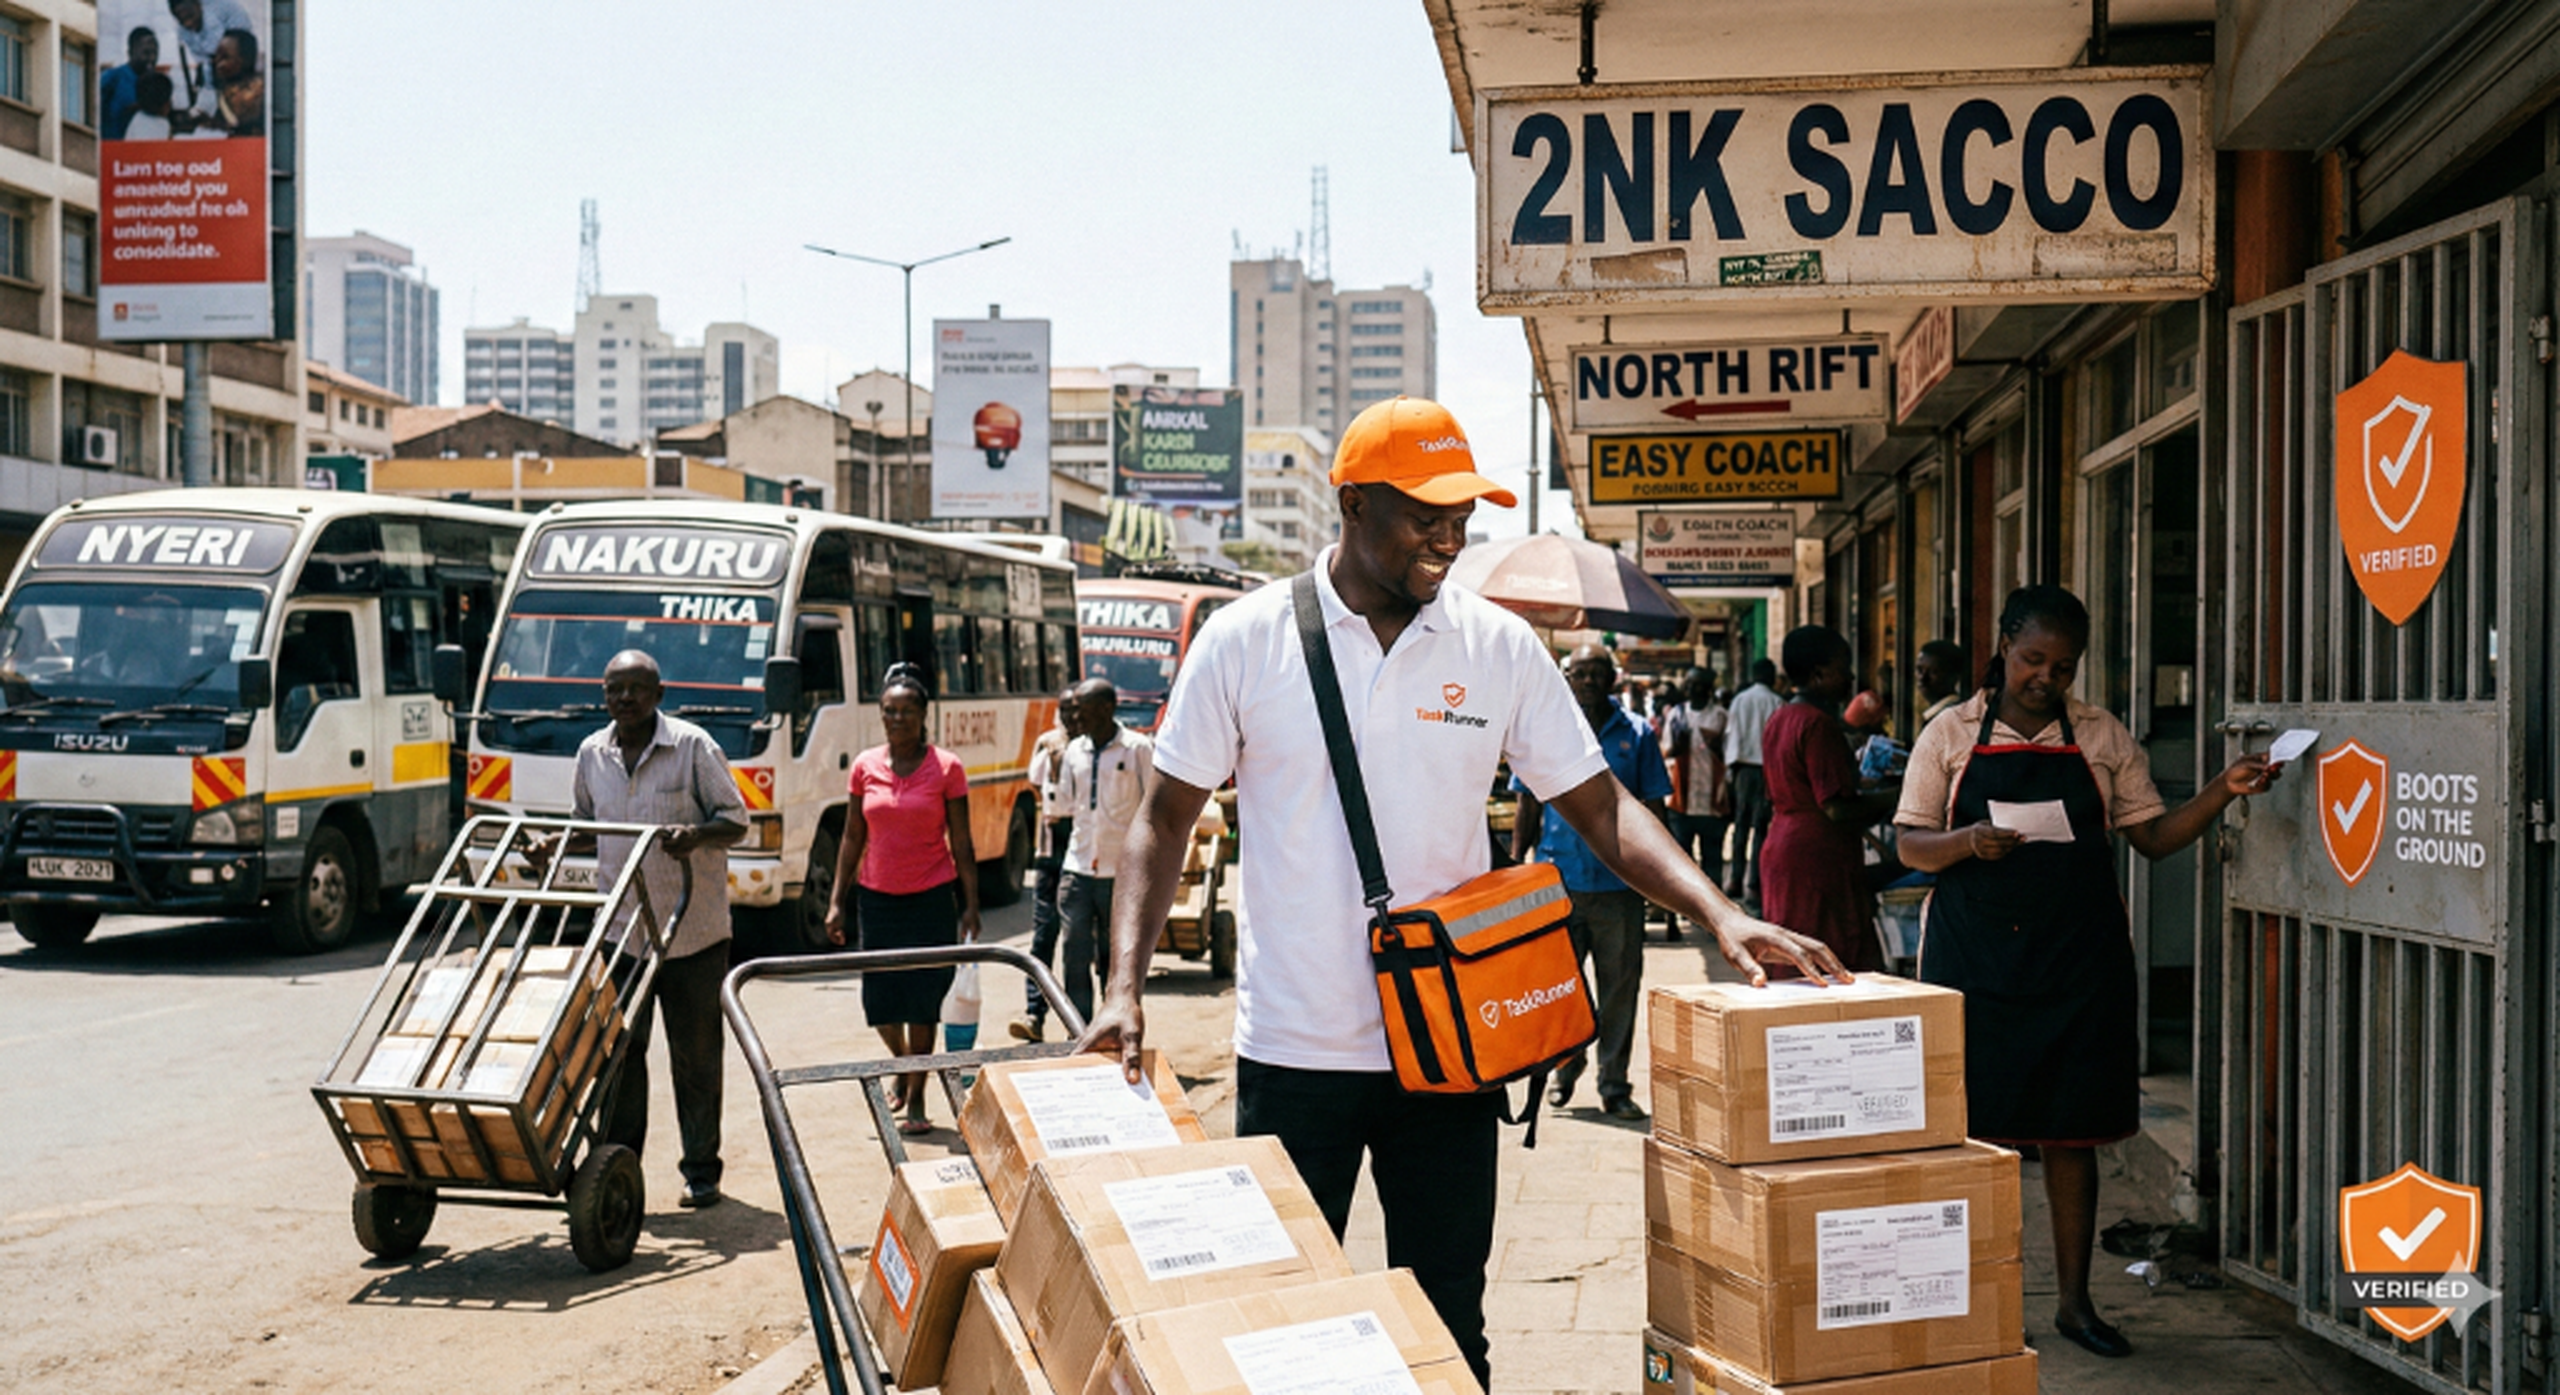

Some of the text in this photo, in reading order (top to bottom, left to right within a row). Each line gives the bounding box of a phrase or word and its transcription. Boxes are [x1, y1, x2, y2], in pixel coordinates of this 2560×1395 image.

[1511, 94, 2183, 245] 2NK SACCO
[194, 182, 228, 200] you
[179, 223, 198, 239] to
[113, 243, 221, 260] consolidate.
[1577, 350, 1750, 401] NORTH
[1768, 344, 1881, 394] RIFT
[1600, 439, 1830, 478] EASY COACH
[1704, 481, 1746, 493] EASY
[1735, 519, 1789, 531] COACH
[77, 524, 254, 566] NYERI
[542, 533, 780, 579] NAKURU
[2359, 544, 2438, 574] VERIFIED
[659, 594, 760, 622] THIKA
[1415, 707, 1488, 728] TaskRunner
[54, 733, 129, 751] ISUZU
[2396, 772, 2479, 802] BOOTS
[2396, 807, 2473, 837] ON THE
[2395, 837, 2486, 869] GROUND
[1502, 976, 1578, 1018] TaskRunner
